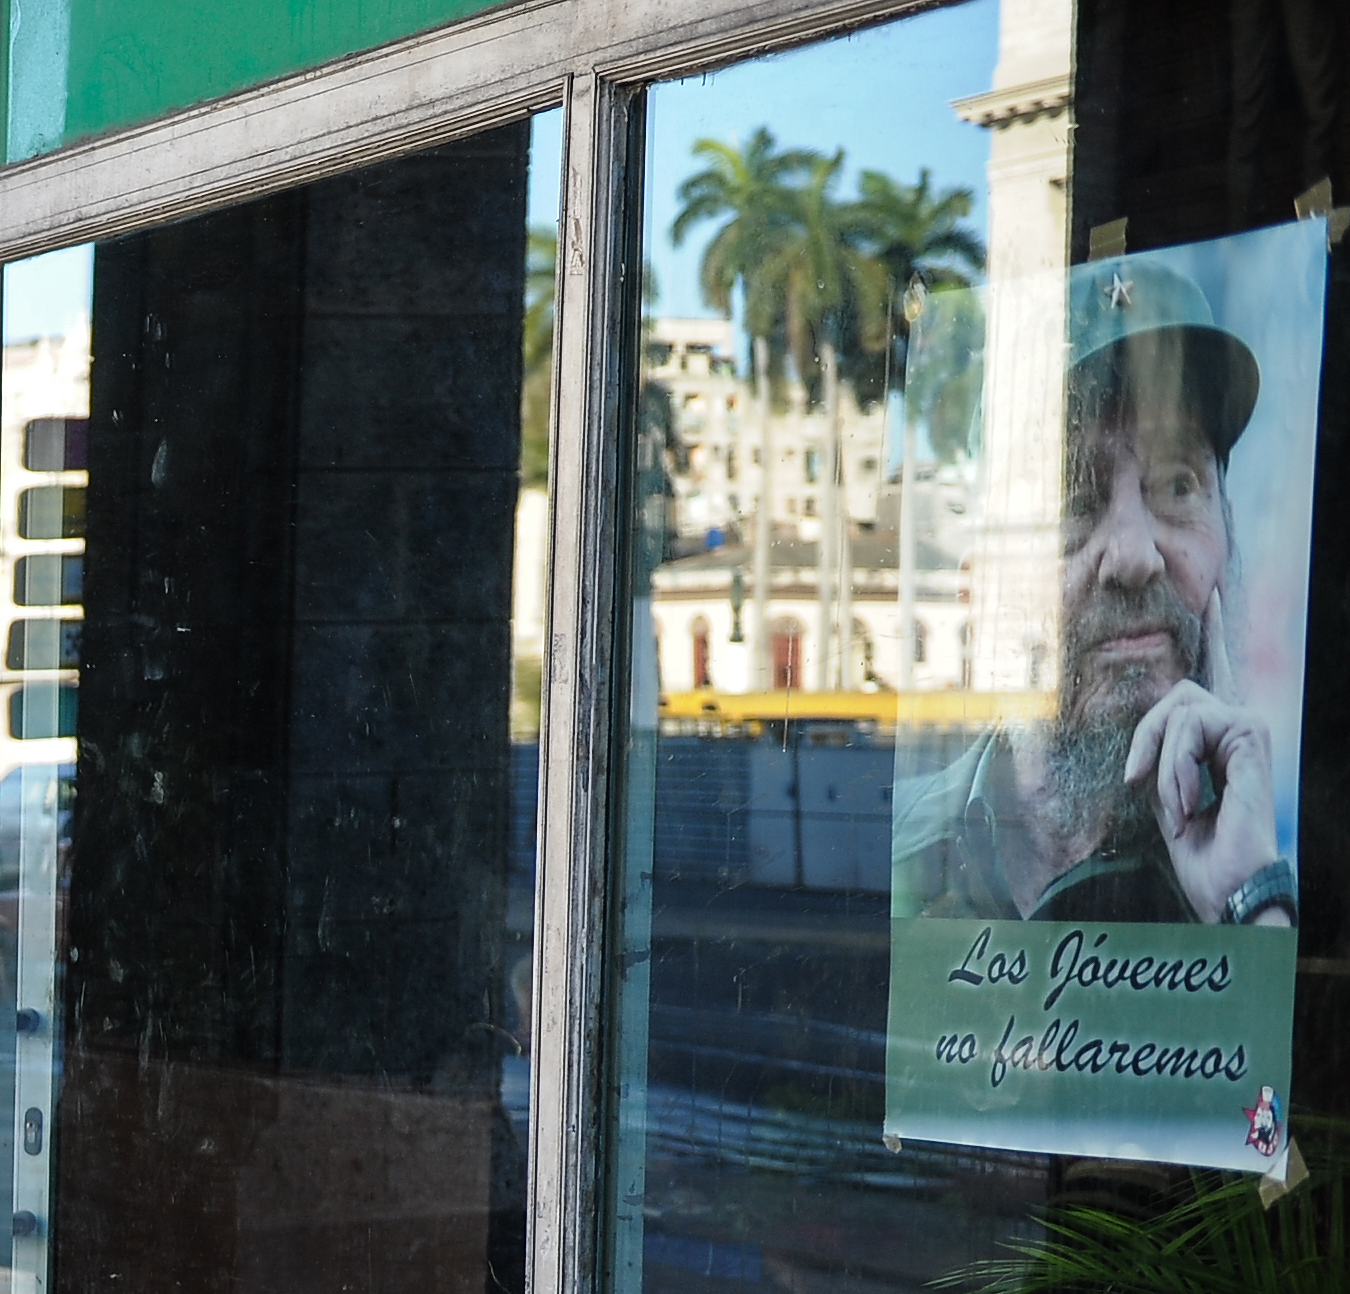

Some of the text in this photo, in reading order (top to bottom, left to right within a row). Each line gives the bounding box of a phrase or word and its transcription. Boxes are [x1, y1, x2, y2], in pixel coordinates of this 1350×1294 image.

[948, 926, 1232, 1011] Los Jóvenes
[936, 1014, 1248, 1088] no fallaremos
